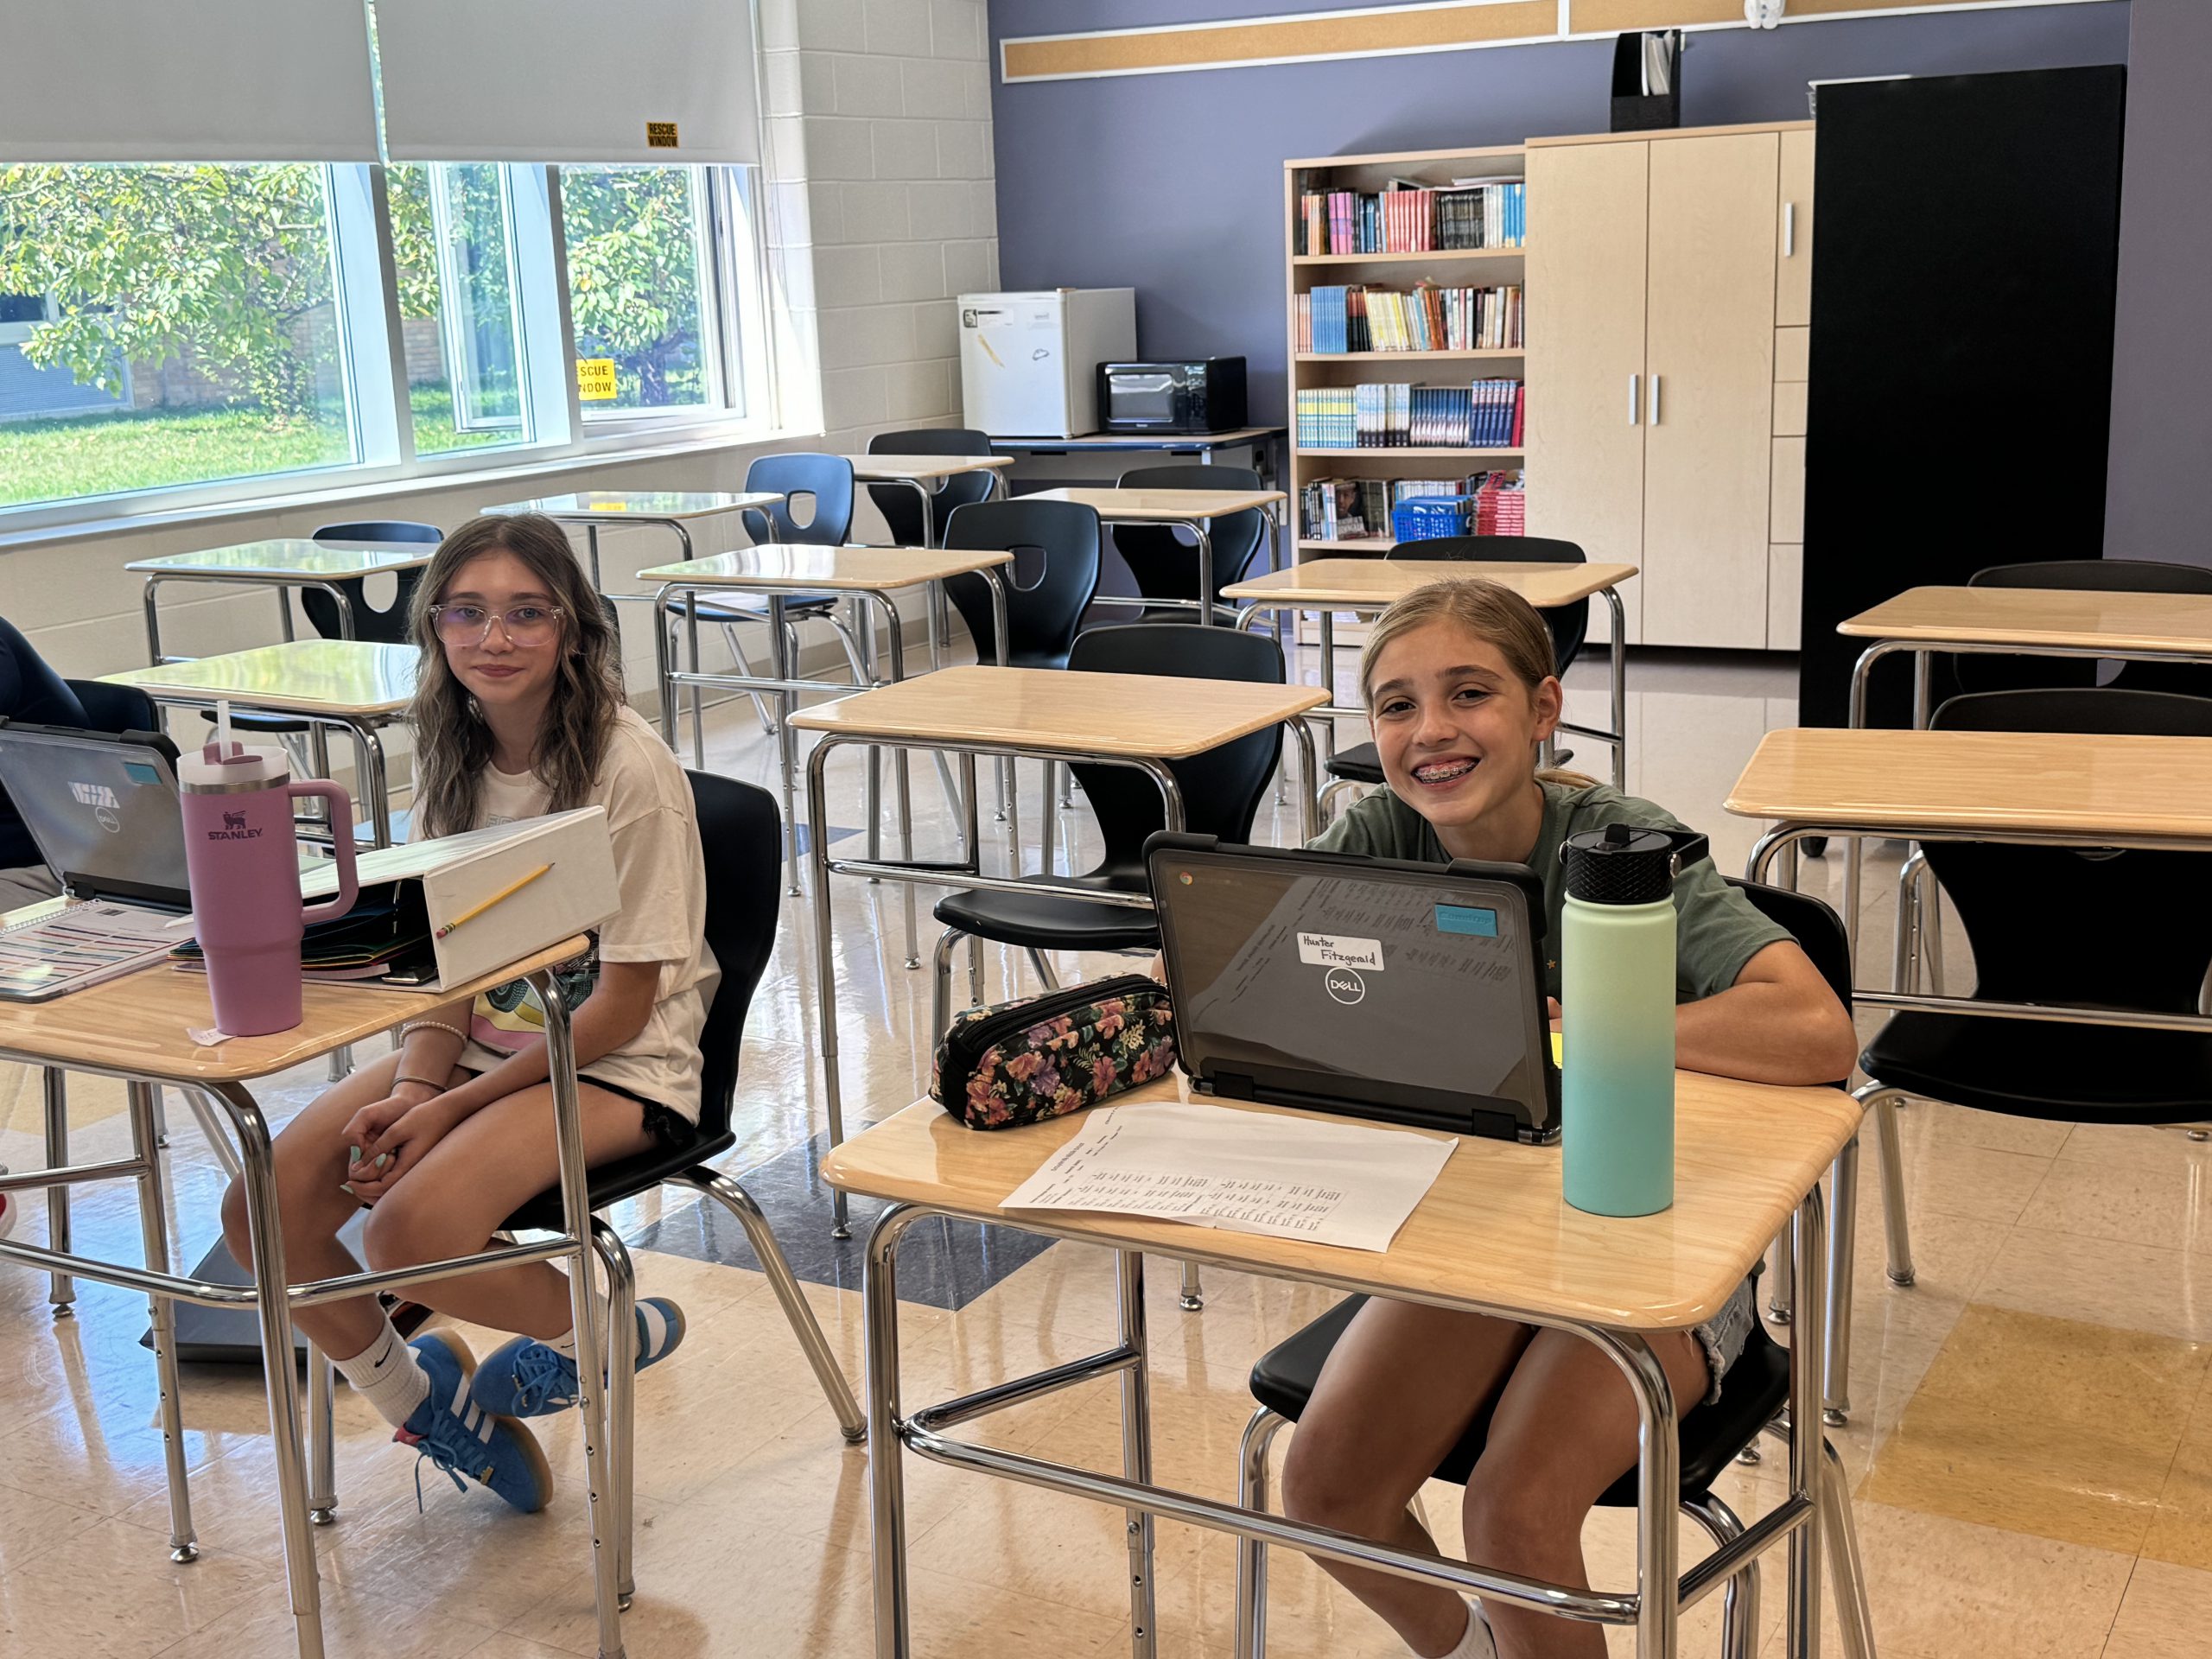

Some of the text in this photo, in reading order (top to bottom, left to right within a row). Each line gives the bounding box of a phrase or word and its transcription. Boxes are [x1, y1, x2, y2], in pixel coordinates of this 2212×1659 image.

[649, 123, 676, 135] RESCUE
[648, 136, 677, 147] WINDOW
[581, 365, 608, 376] SCUE
[208, 828, 263, 840] STANLEY
[1303, 935, 1334, 948] Hunter
[1320, 950, 1376, 966] Fitzgerald
[1330, 979, 1362, 992] DELL
